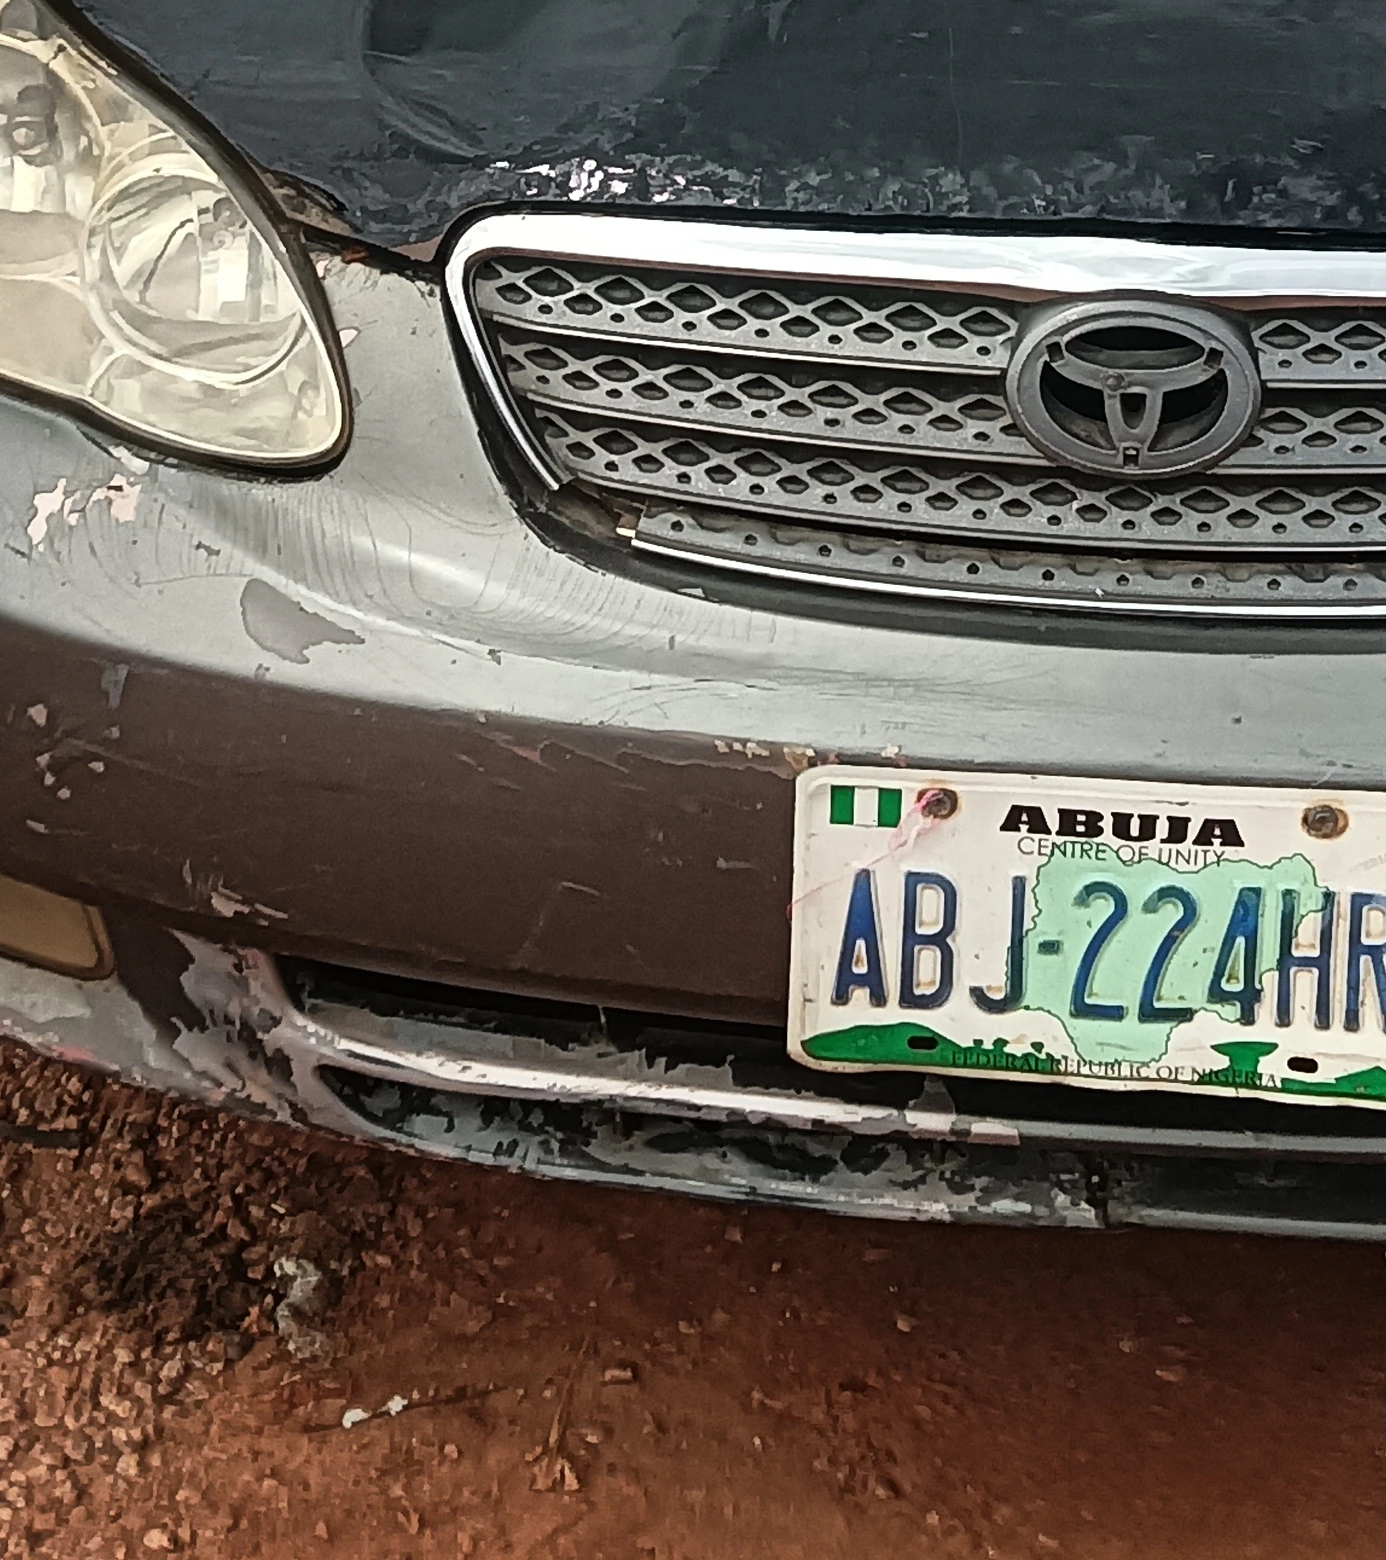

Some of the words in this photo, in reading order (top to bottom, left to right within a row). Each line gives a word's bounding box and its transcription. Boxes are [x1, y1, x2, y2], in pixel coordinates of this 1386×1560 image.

[999, 804, 1246, 848] ABUJA
[1017, 836, 1108, 862] CENTRE
[1117, 844, 1150, 865] OF
[1158, 846, 1226, 868] UNITY
[952, 1049, 1047, 1074] FEDERAL
[1050, 1056, 1151, 1080] REPUBLIC
[1155, 1064, 1184, 1081] OF
[1190, 1065, 1281, 1088] NIGERIA
